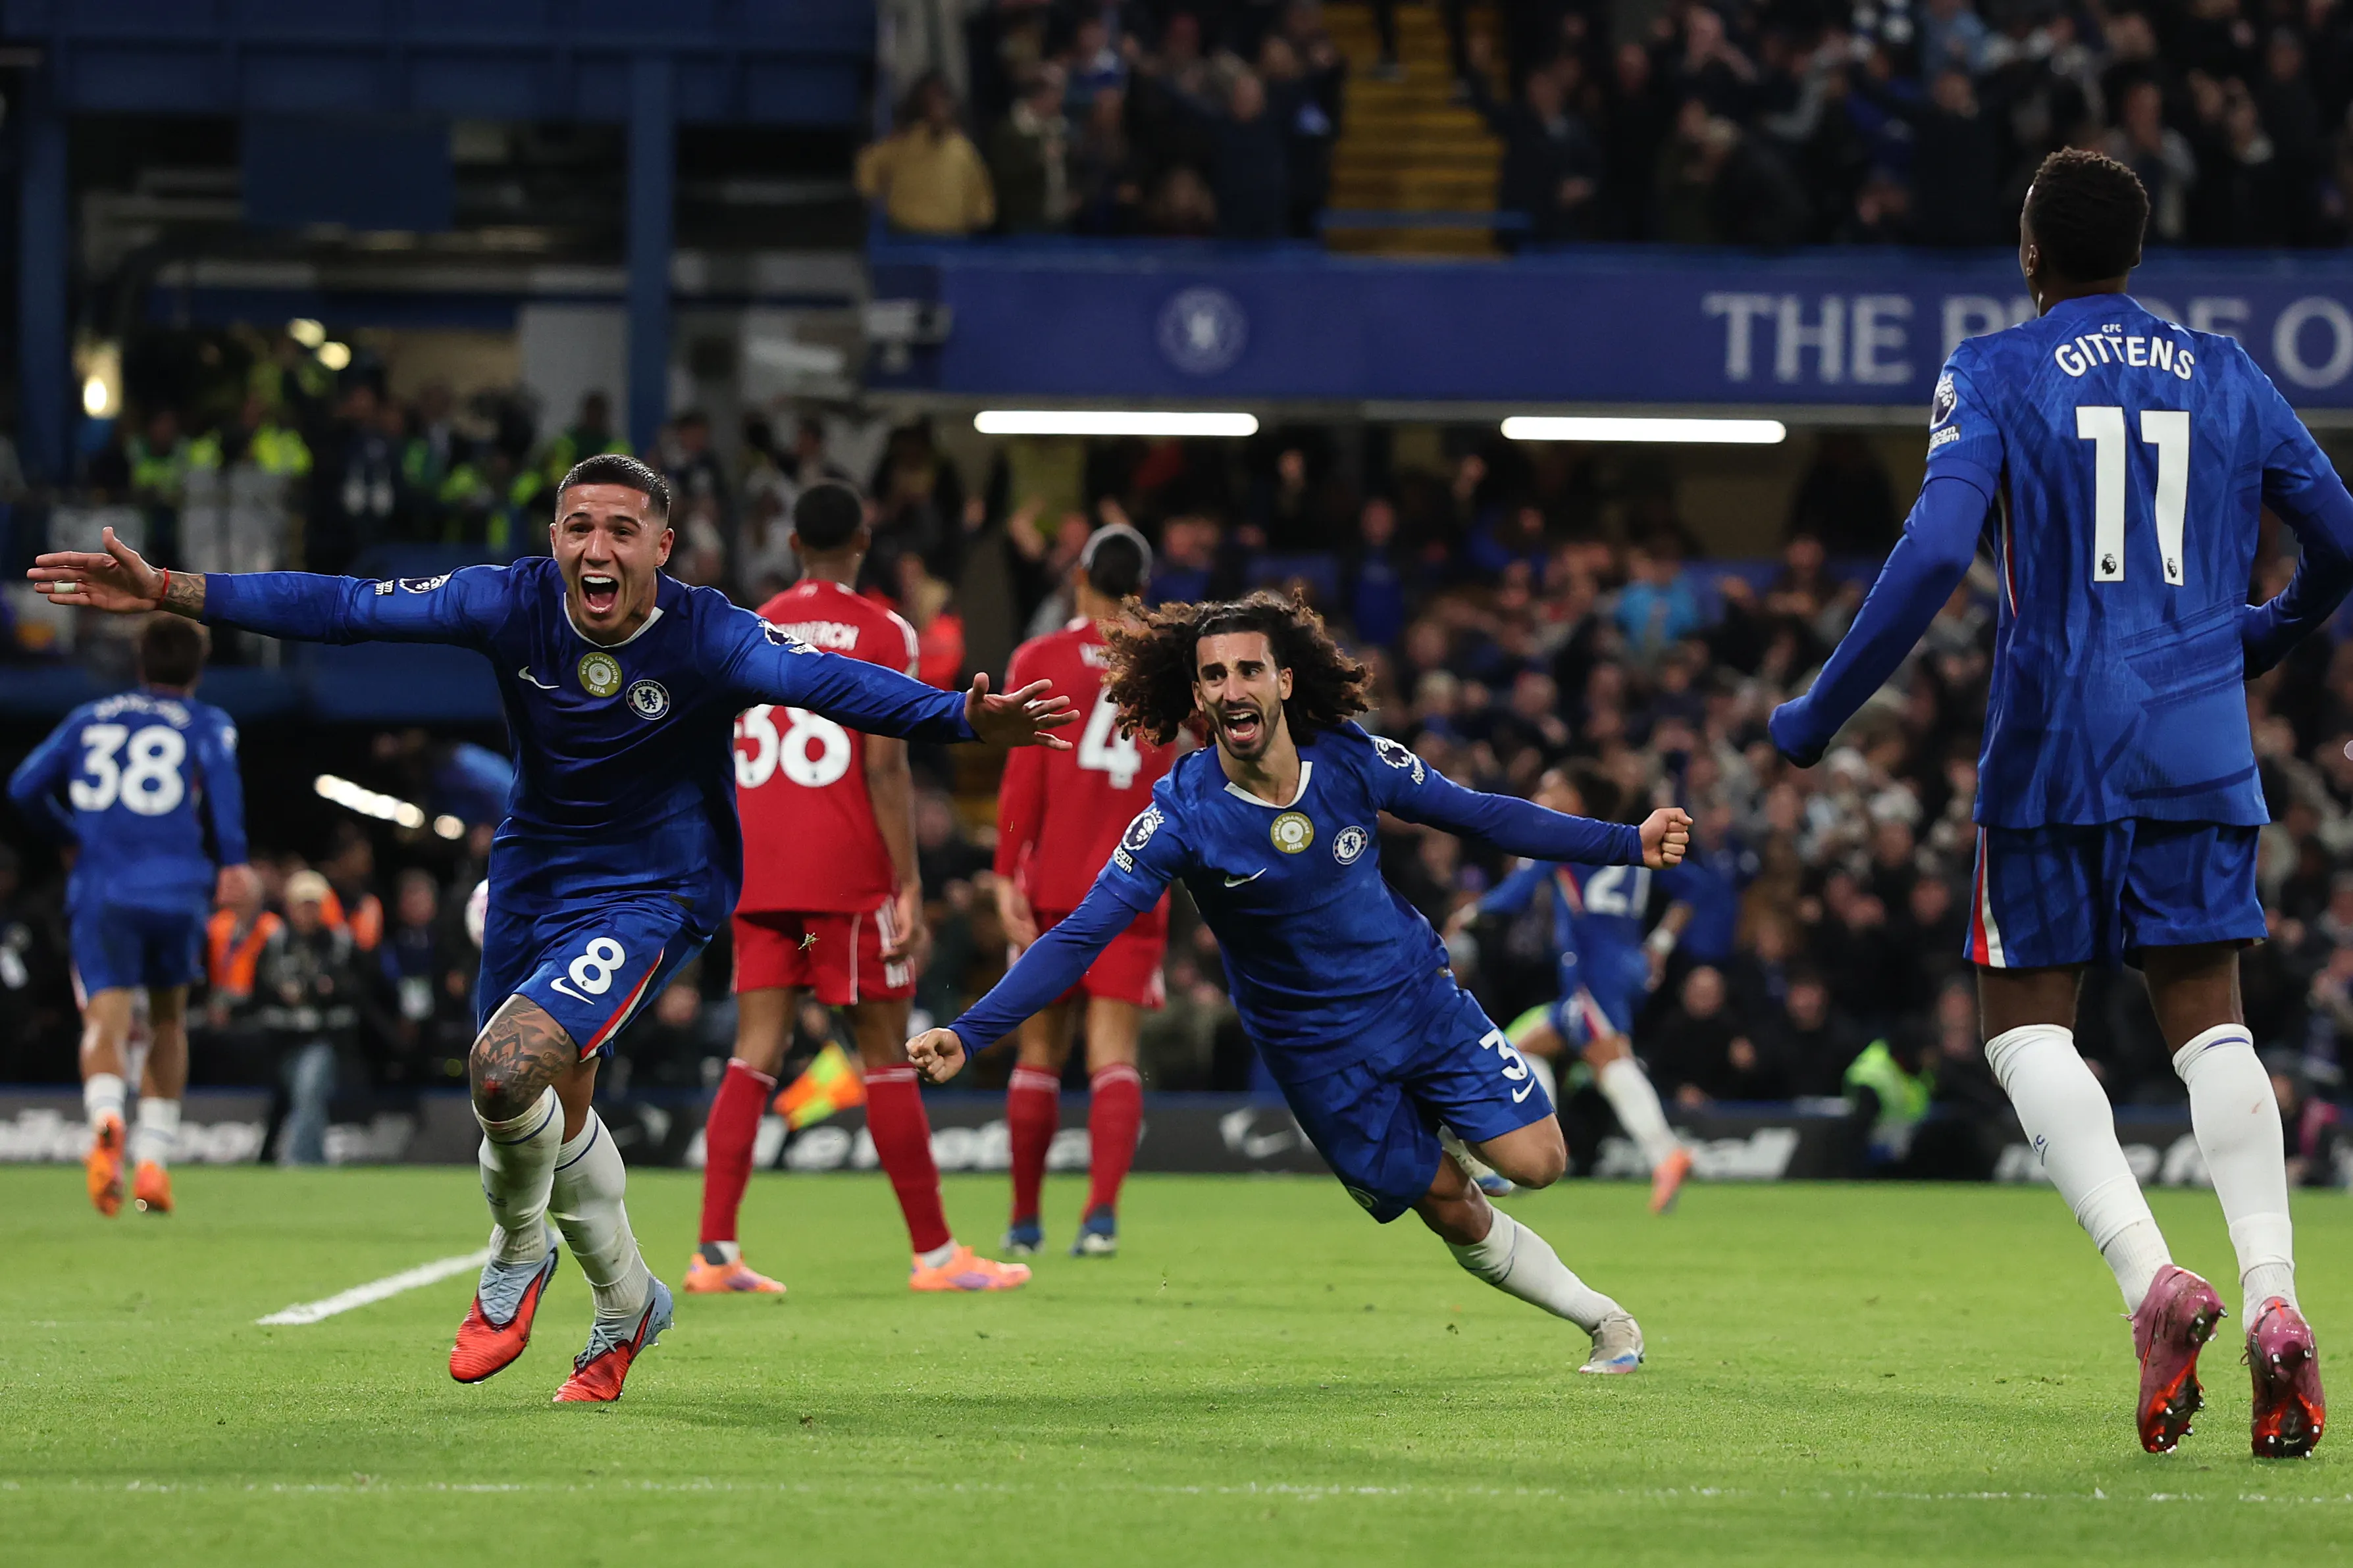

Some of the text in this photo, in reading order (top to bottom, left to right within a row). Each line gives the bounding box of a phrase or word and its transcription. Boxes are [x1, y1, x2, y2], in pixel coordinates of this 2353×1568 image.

[1703, 291, 1915, 386] THE
[2102, 324, 2122, 333] CFC
[2054, 333, 2195, 380] GITTENS
[2075, 405, 2190, 586] 11
[582, 656, 619, 684] WORLD CHAMPIONS
[588, 684, 606, 694] FIFA
[631, 681, 659, 691] CHELSEA
[1077, 686, 1142, 790] 4
[68, 724, 187, 817] 38
[1287, 842, 1304, 851] FIFA
[569, 937, 625, 994] 8
[1478, 1028, 1528, 1080] 3
